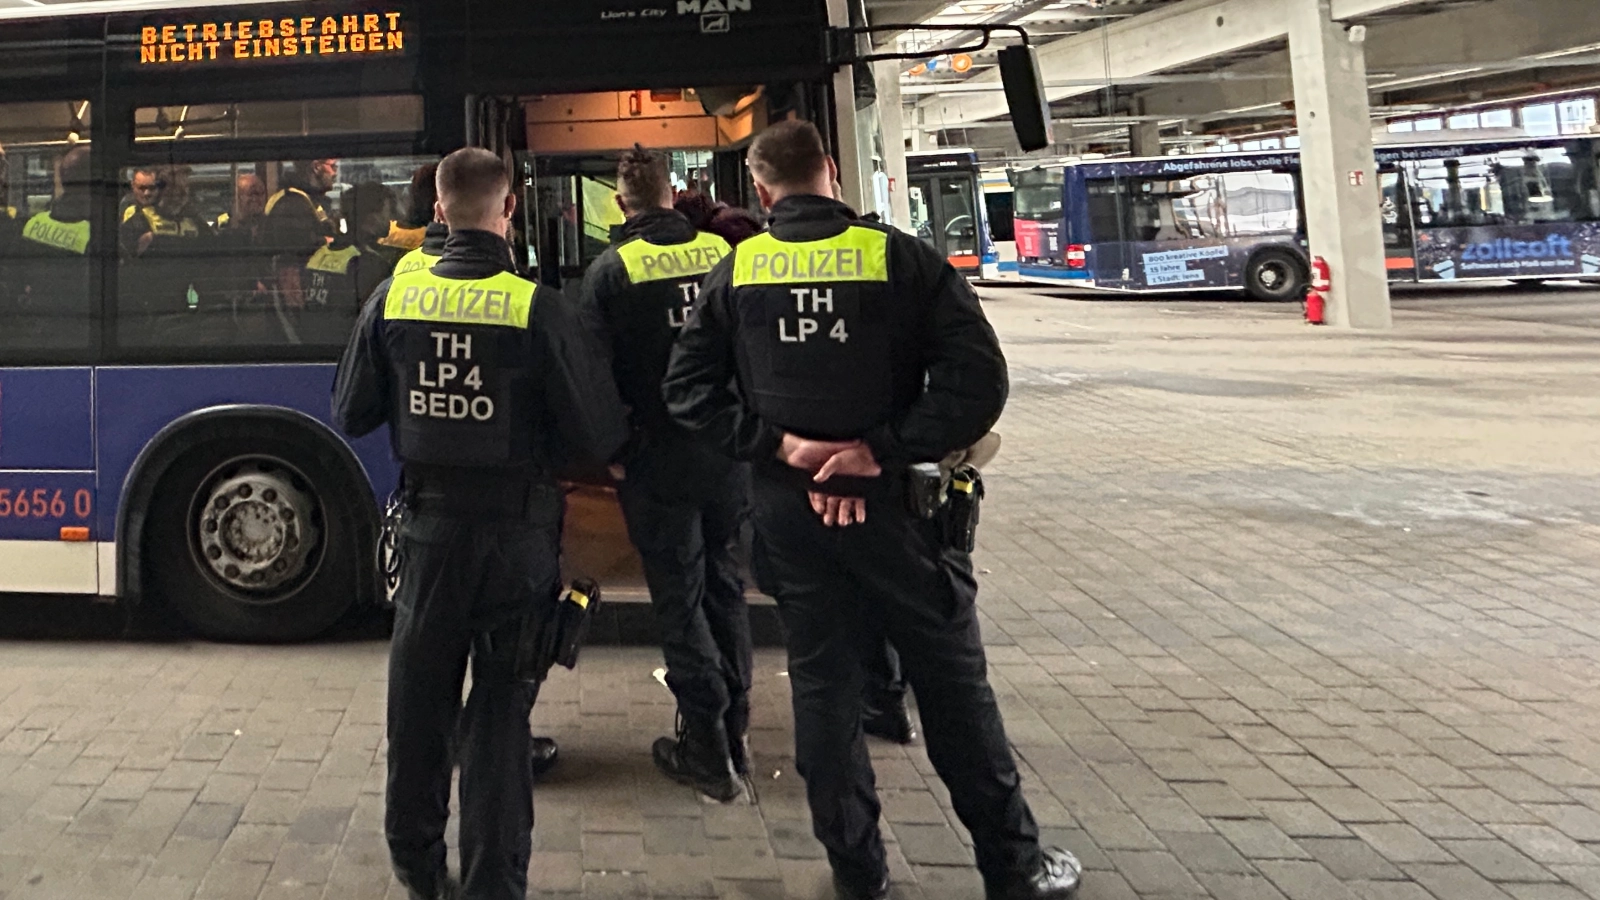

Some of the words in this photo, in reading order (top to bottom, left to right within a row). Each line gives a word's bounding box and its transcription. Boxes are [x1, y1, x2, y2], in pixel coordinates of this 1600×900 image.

[601, 10, 635, 19] Lion's
[640, 8, 667, 17] City
[676, 0, 751, 14] MAN
[141, 12, 400, 45] BETRIEBSFAHRT
[141, 41, 220, 64] NICHT
[234, 31, 403, 59] EINSTEIGEN
[1163, 161, 1229, 173] Abgefahrene
[1401, 150, 1419, 158] bei
[29, 221, 78, 248] POLIZEI
[1461, 233, 1573, 260] zollsoft
[641, 246, 723, 279] POLIZEI
[751, 248, 863, 281] POLIZEI
[1165, 252, 1197, 260] kreative
[400, 285, 511, 320] POLIZEI
[790, 287, 834, 313] TH
[778, 317, 819, 342] LP
[829, 318, 849, 343] 4
[430, 331, 472, 360] TH
[419, 361, 458, 388] LP
[463, 365, 483, 391] 4
[409, 390, 494, 421] BEDO
[73, 487, 92, 519] 0
